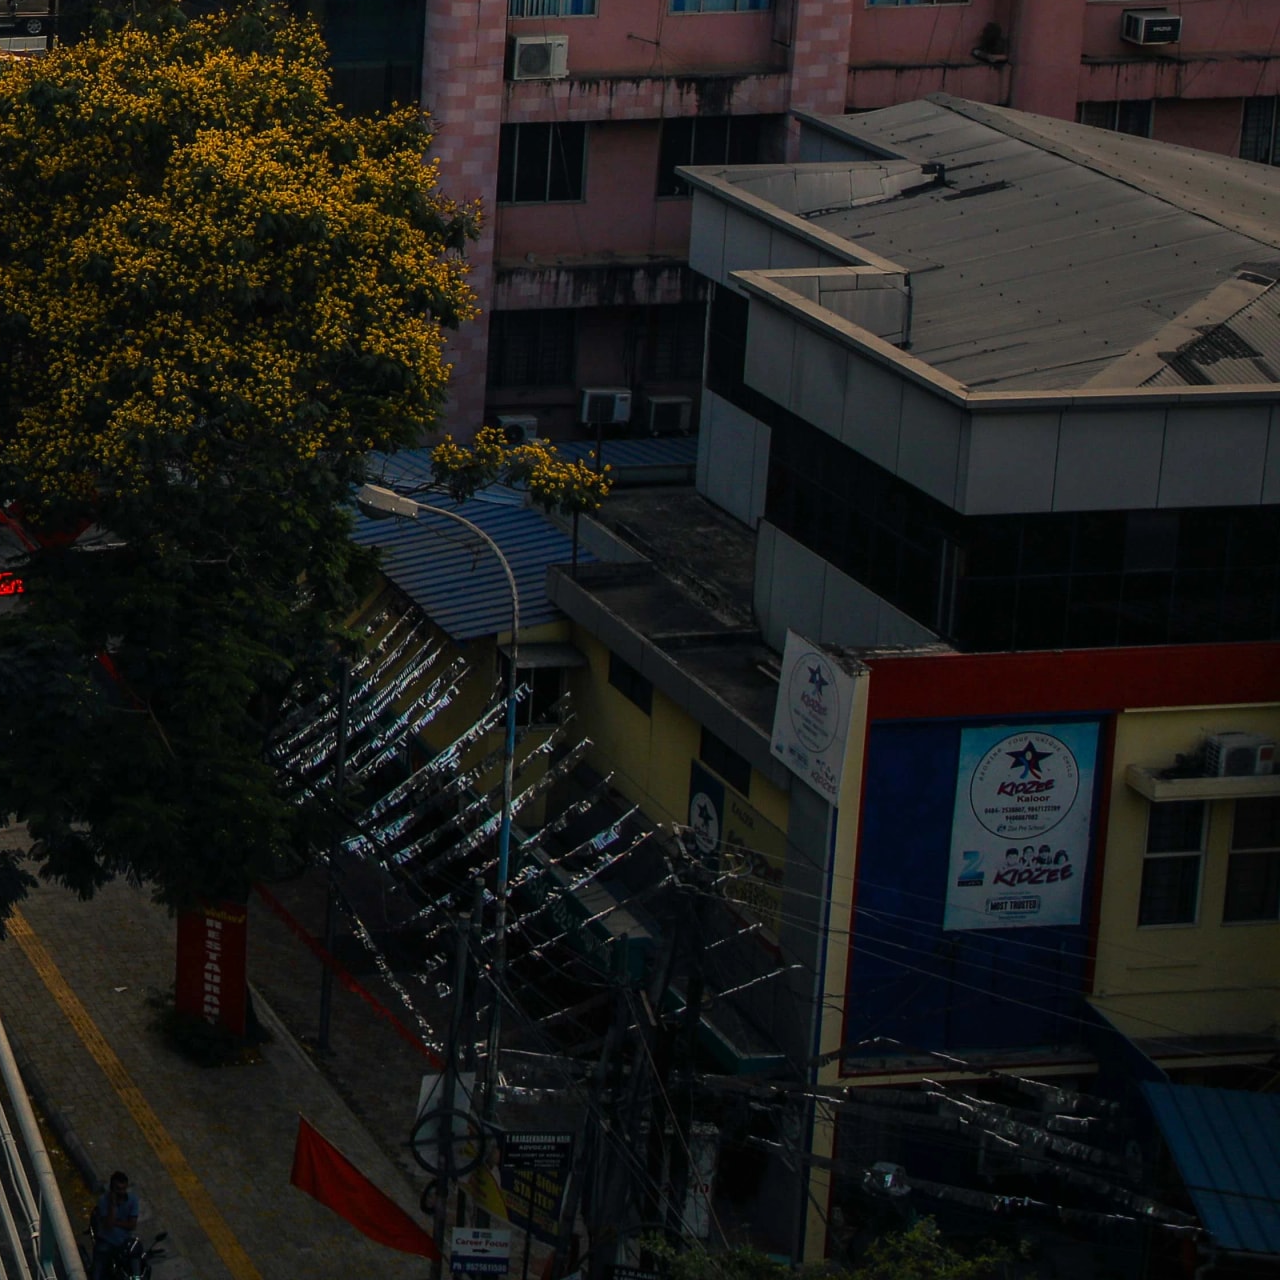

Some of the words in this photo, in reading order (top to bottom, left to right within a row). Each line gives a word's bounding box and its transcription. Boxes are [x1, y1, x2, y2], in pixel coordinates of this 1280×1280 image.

[997, 779, 1055, 797] KIDZEE
[1017, 795, 1050, 803] Kaloor
[992, 864, 1074, 887] KIDZEE
[990, 901, 1007, 910] MOST
[1009, 900, 1037, 910] TRUSTED
[485, 1239, 508, 1248] Focus
